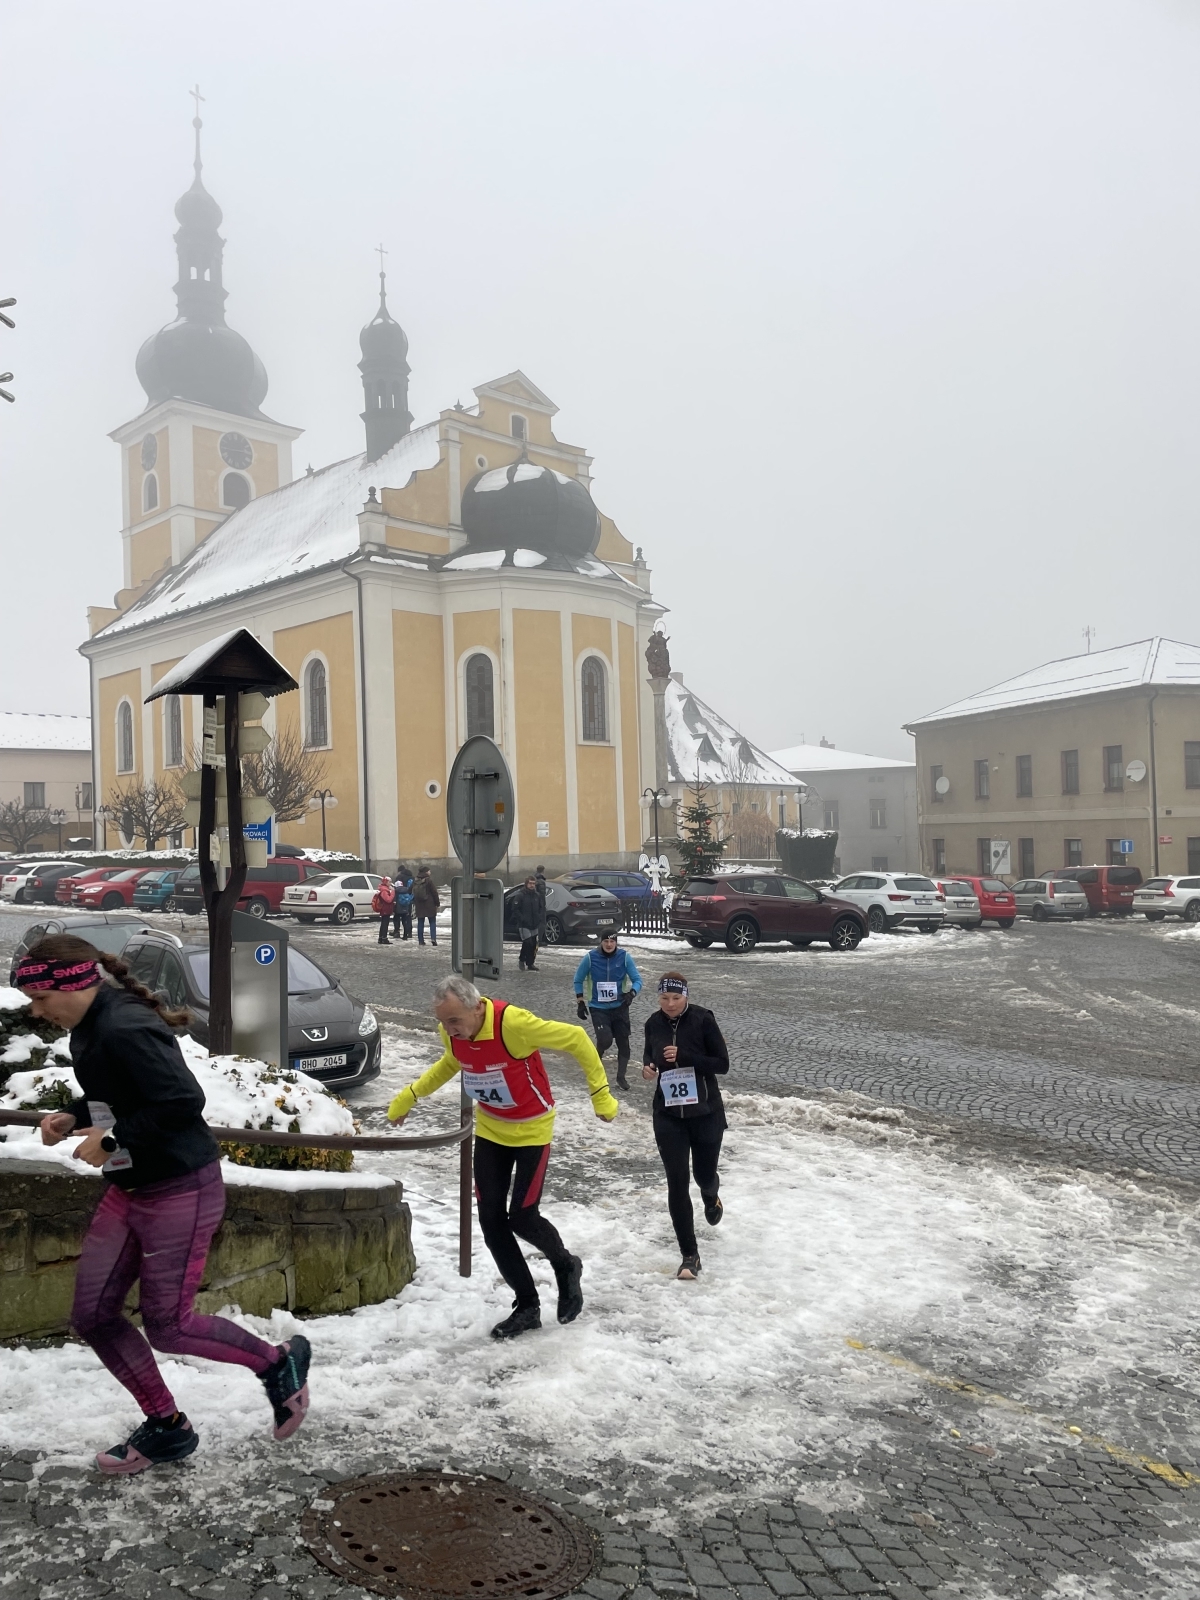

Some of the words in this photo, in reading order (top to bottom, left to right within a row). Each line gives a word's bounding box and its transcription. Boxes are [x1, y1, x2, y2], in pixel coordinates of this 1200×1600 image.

[261, 948, 271, 961] P
[53, 960, 94, 978] SWEEP
[600, 989, 614, 998] 116
[323, 1056, 343, 1067] 2045
[474, 1088, 503, 1103] 34
[669, 1082, 689, 1098] 28
